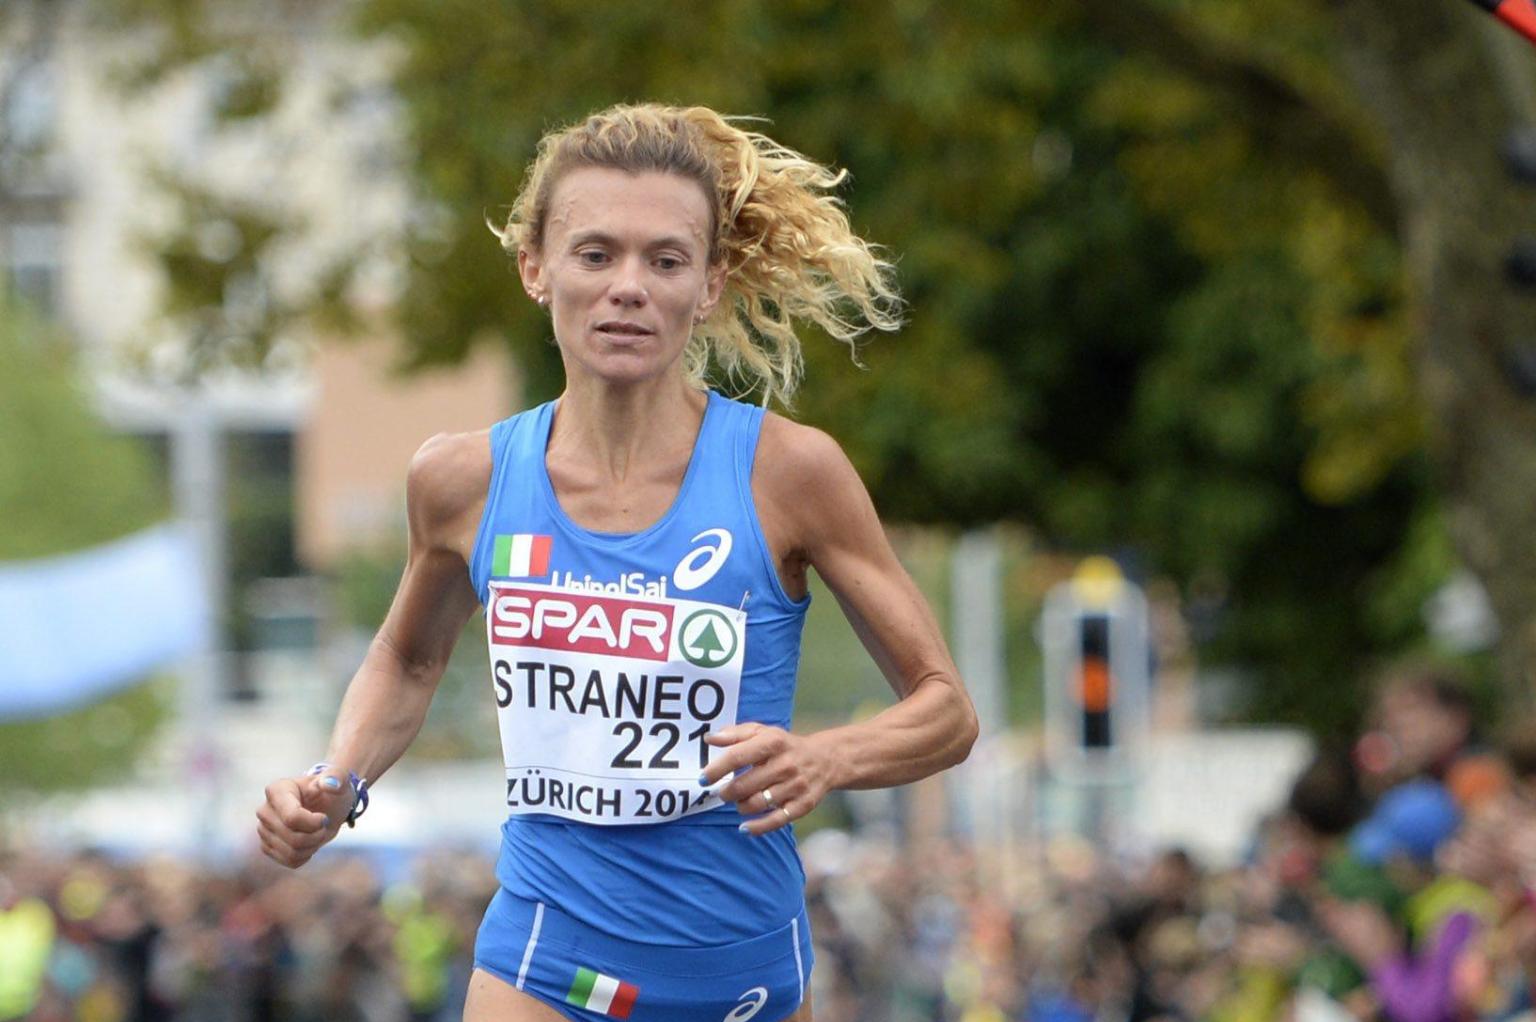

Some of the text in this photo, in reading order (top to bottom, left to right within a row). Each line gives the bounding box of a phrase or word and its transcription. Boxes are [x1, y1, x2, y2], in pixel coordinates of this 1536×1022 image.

[494, 596, 668, 654] SPAR
[494, 660, 725, 722] STRANEO
[611, 722, 711, 770] 221
[506, 769, 621, 817] ZÜRICH
